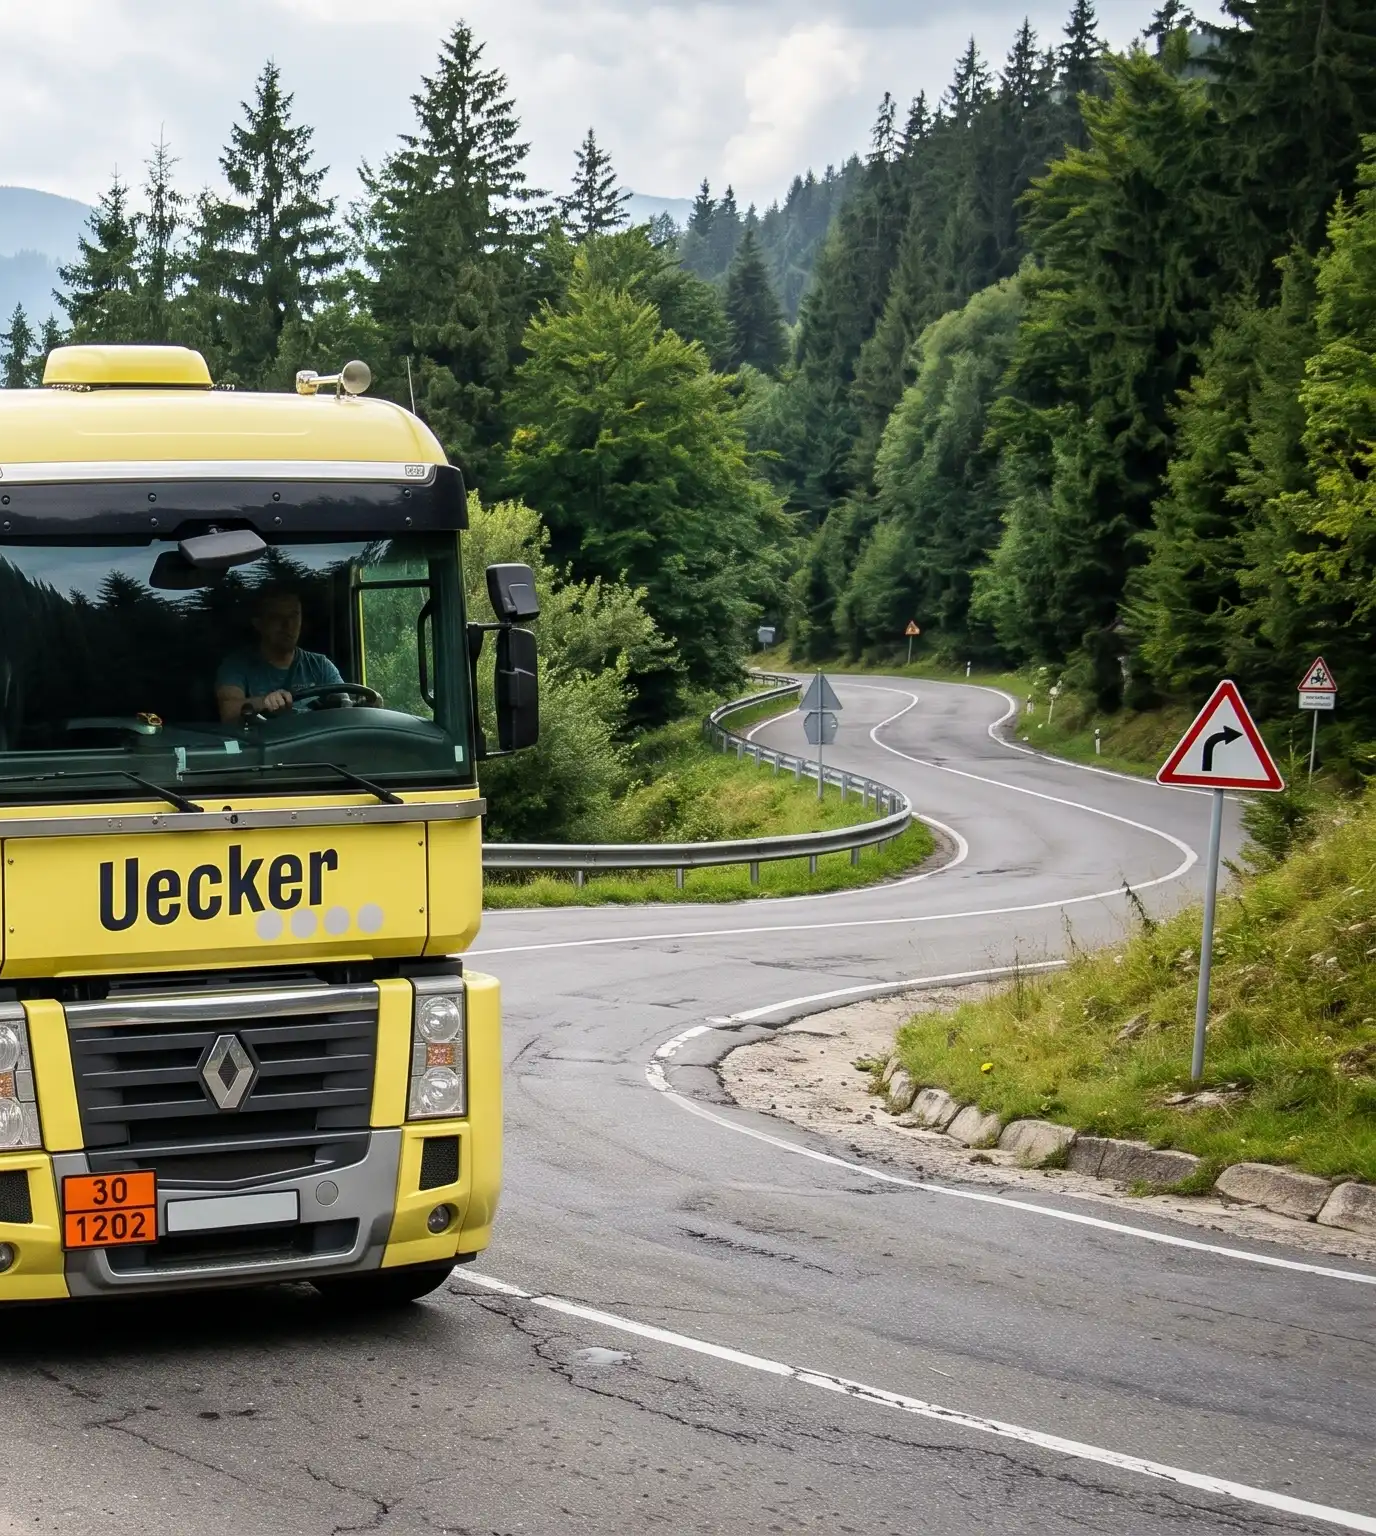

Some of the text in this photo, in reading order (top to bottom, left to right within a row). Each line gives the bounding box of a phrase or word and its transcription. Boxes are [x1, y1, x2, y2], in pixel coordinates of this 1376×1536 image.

[99, 844, 339, 932] Uecker
[92, 1177, 128, 1206] 30
[76, 1211, 146, 1243] 1202
